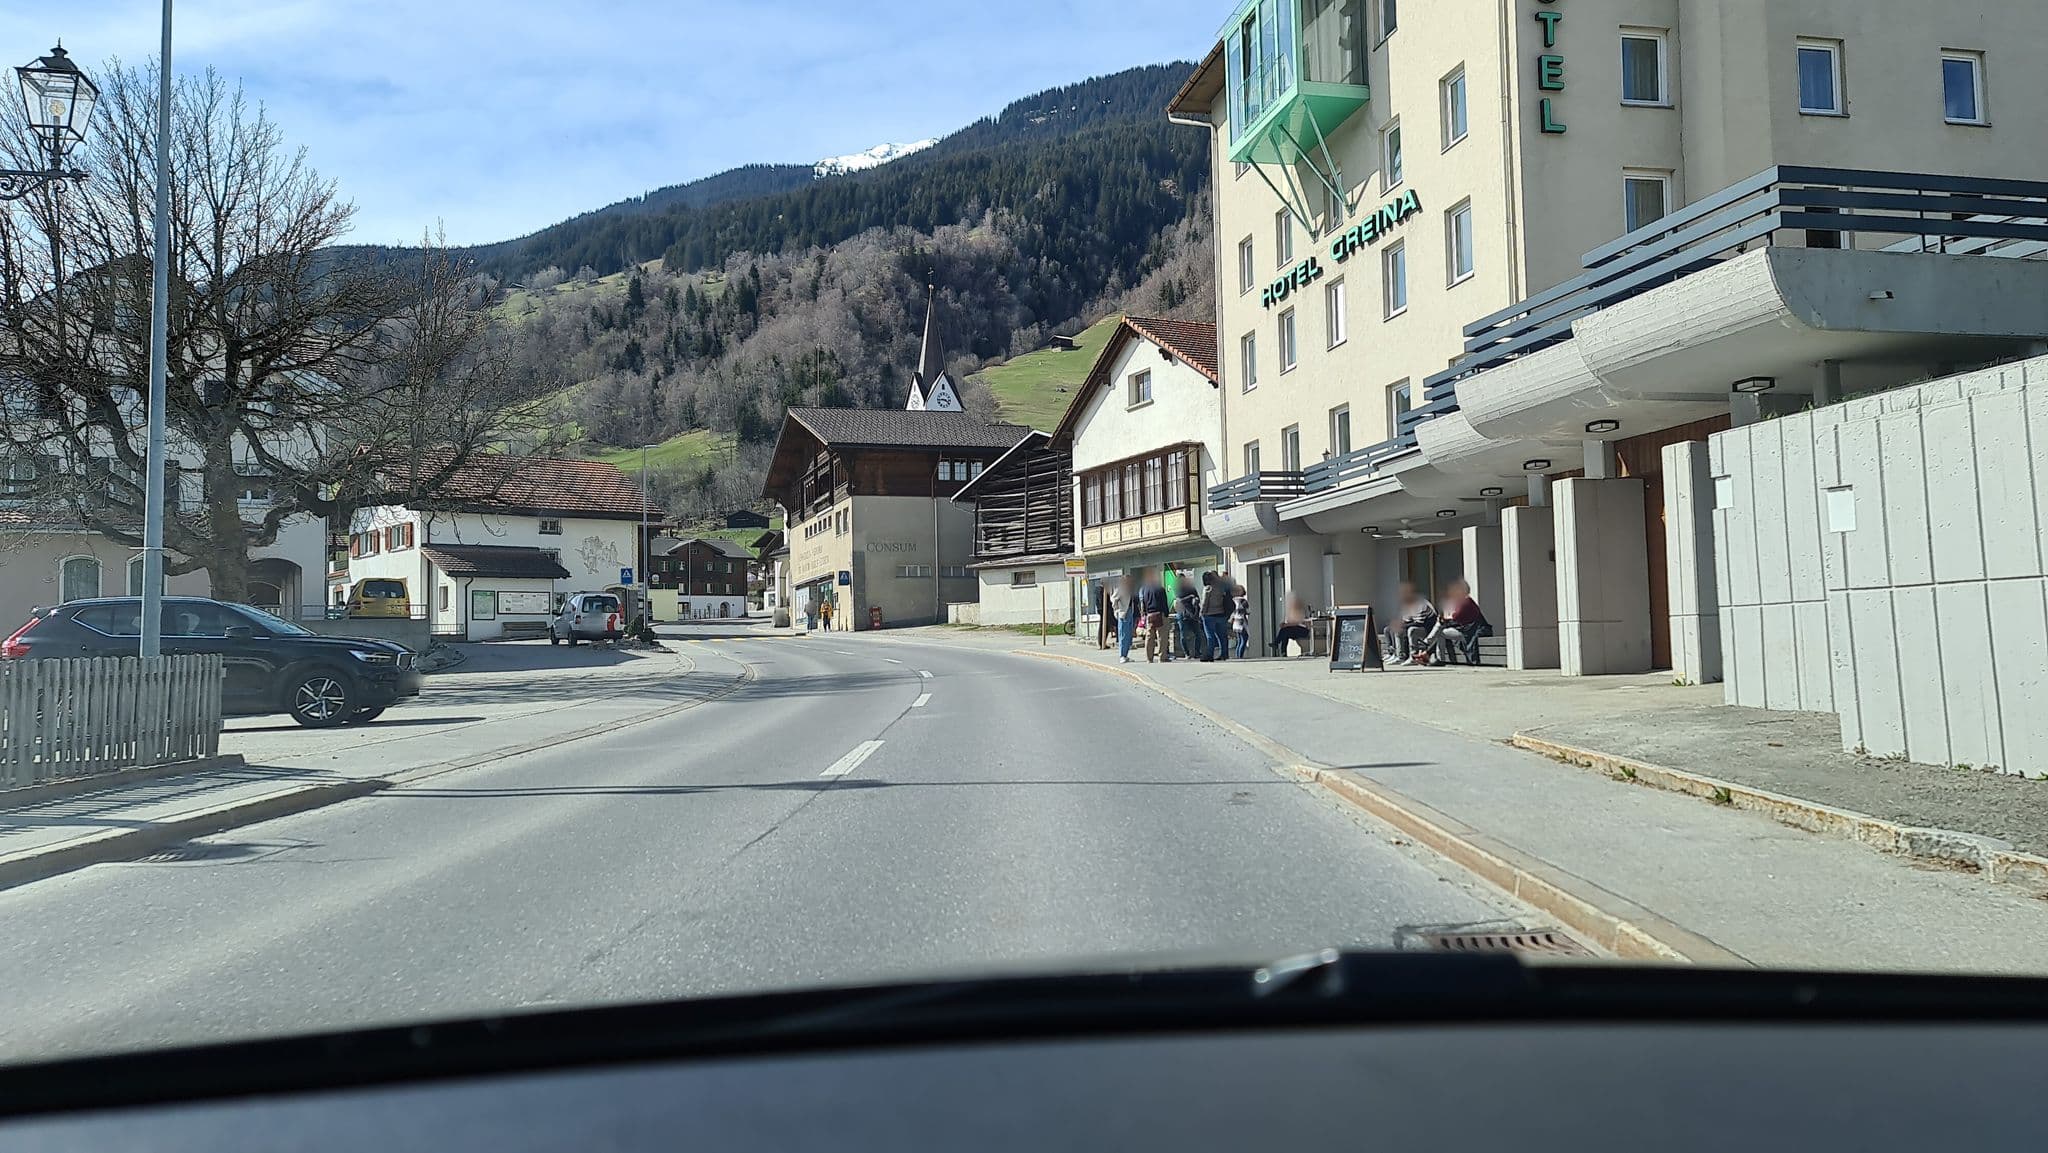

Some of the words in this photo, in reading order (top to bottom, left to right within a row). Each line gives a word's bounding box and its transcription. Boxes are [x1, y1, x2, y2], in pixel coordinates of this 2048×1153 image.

[1534, 0, 1567, 134] TEL
[1260, 257, 1323, 309] HOTEL
[1330, 189, 1423, 264] GREINA
[866, 543, 917, 553] CONSUM
